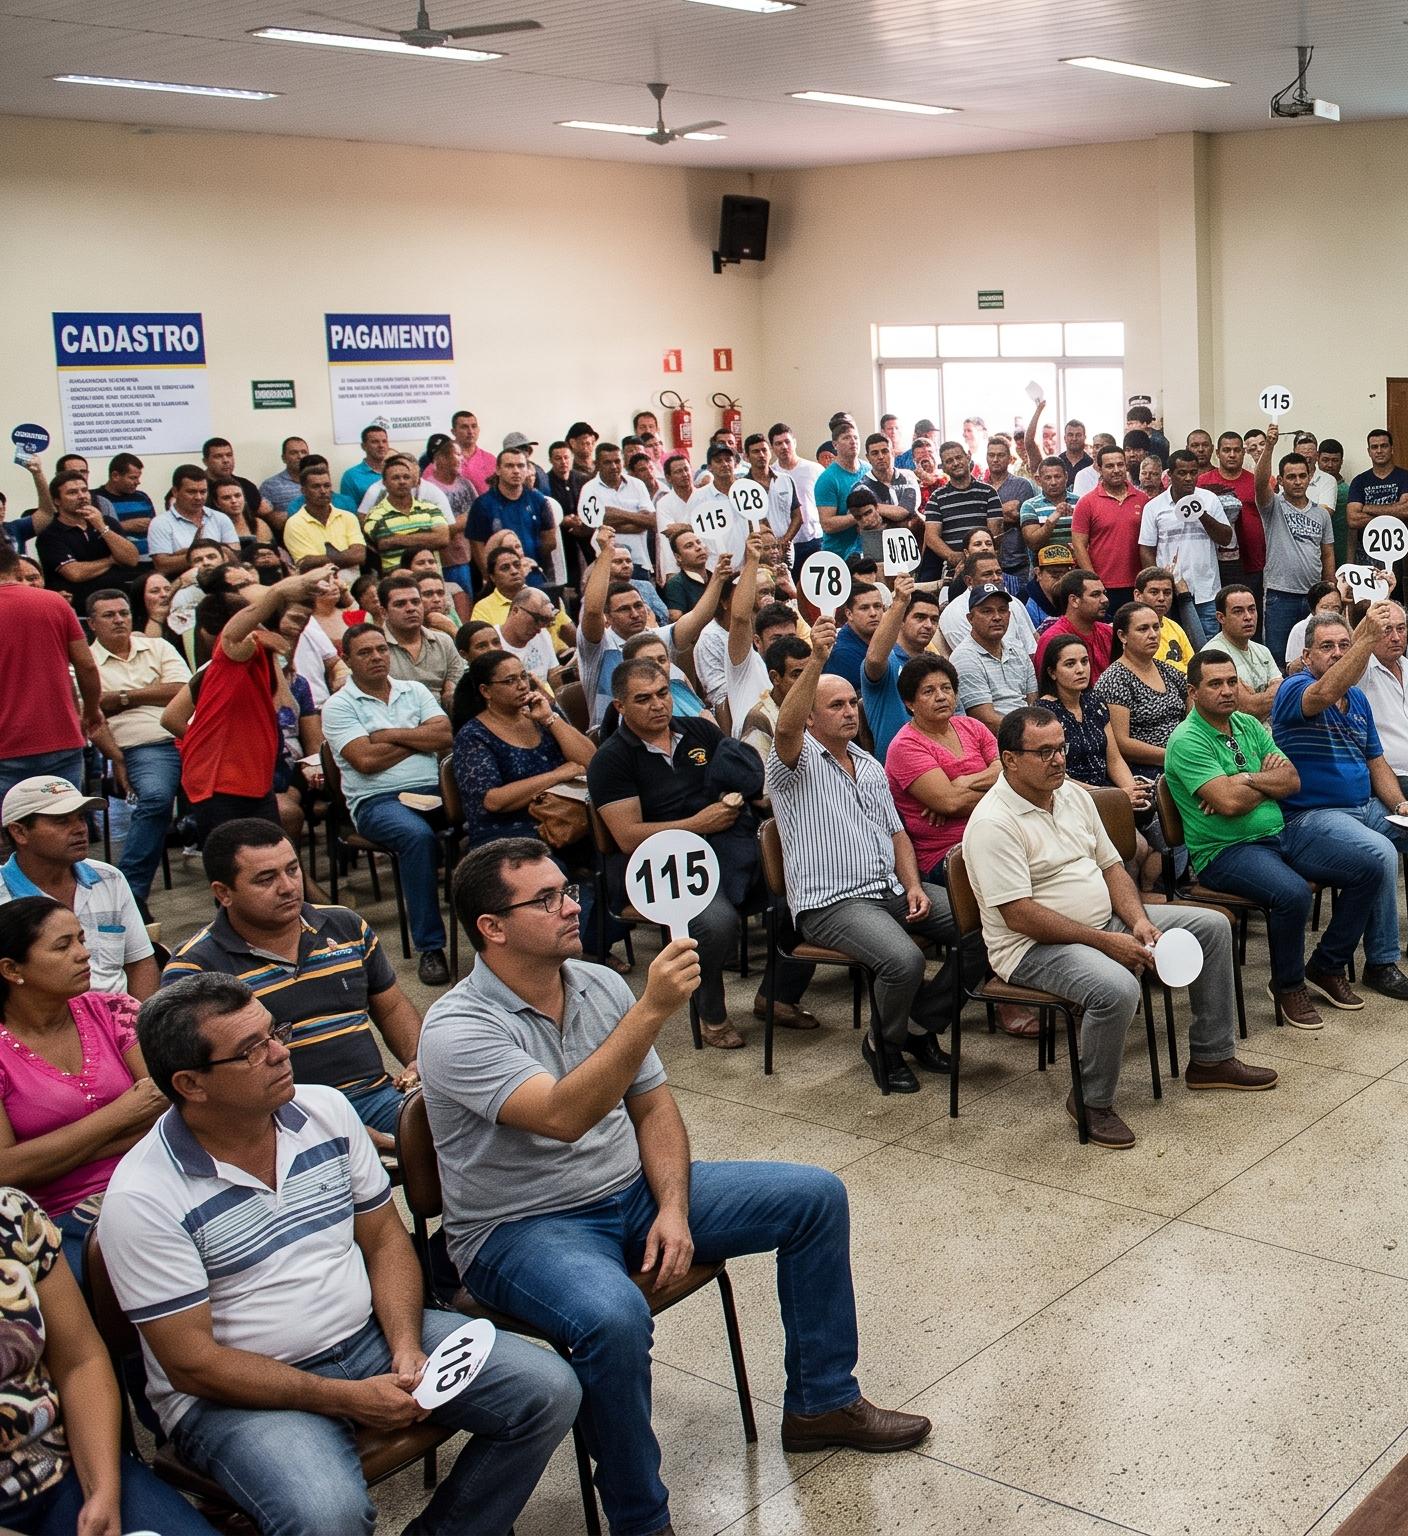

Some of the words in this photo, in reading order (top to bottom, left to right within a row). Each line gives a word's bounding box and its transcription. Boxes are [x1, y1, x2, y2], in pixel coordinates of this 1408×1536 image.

[61, 324, 199, 353] CADASTRO
[330, 325, 450, 349] PAGAMENTO
[1261, 393, 1290, 410] 115
[733, 488, 763, 511] 128
[696, 509, 726, 532] 115
[1368, 528, 1405, 552] 203
[809, 566, 842, 596] 78
[636, 850, 709, 904] 115
[436, 1337, 474, 1392] 115
